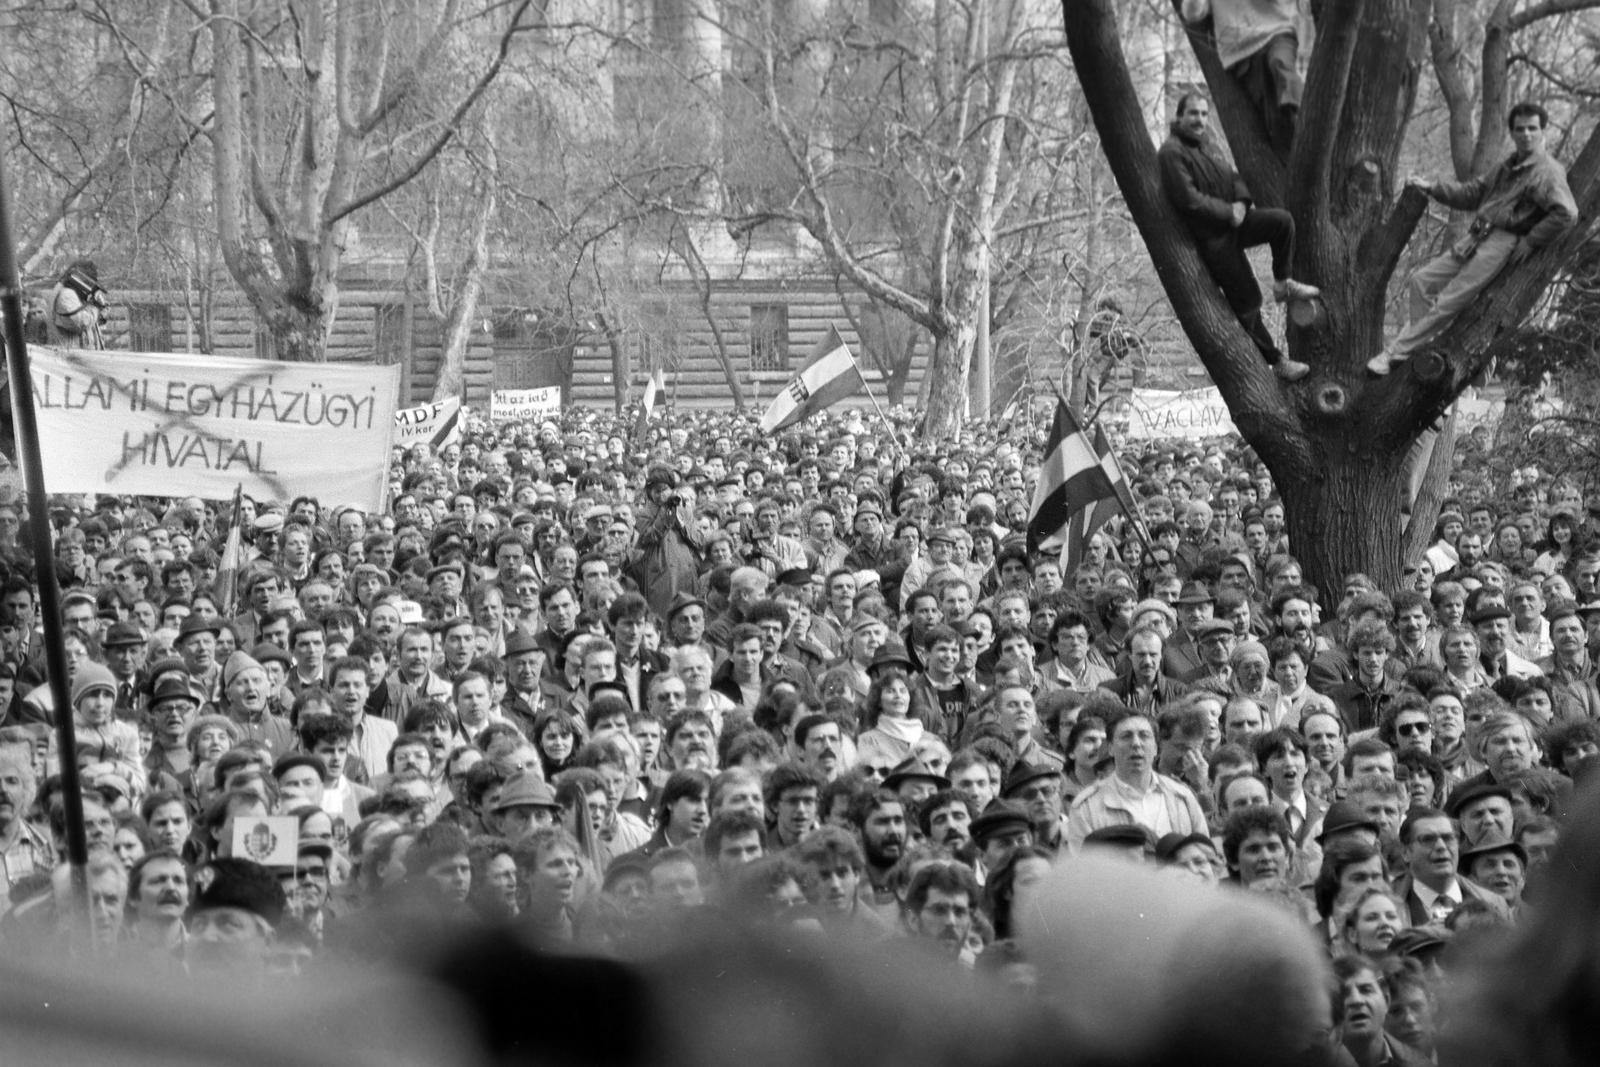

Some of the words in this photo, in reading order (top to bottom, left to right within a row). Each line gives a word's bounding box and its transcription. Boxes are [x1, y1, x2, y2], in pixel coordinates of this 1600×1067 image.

[165, 375, 376, 429] EGYHÁZÜGYI
[395, 402, 444, 427] MDF
[121, 423, 277, 476] HIVATAL
